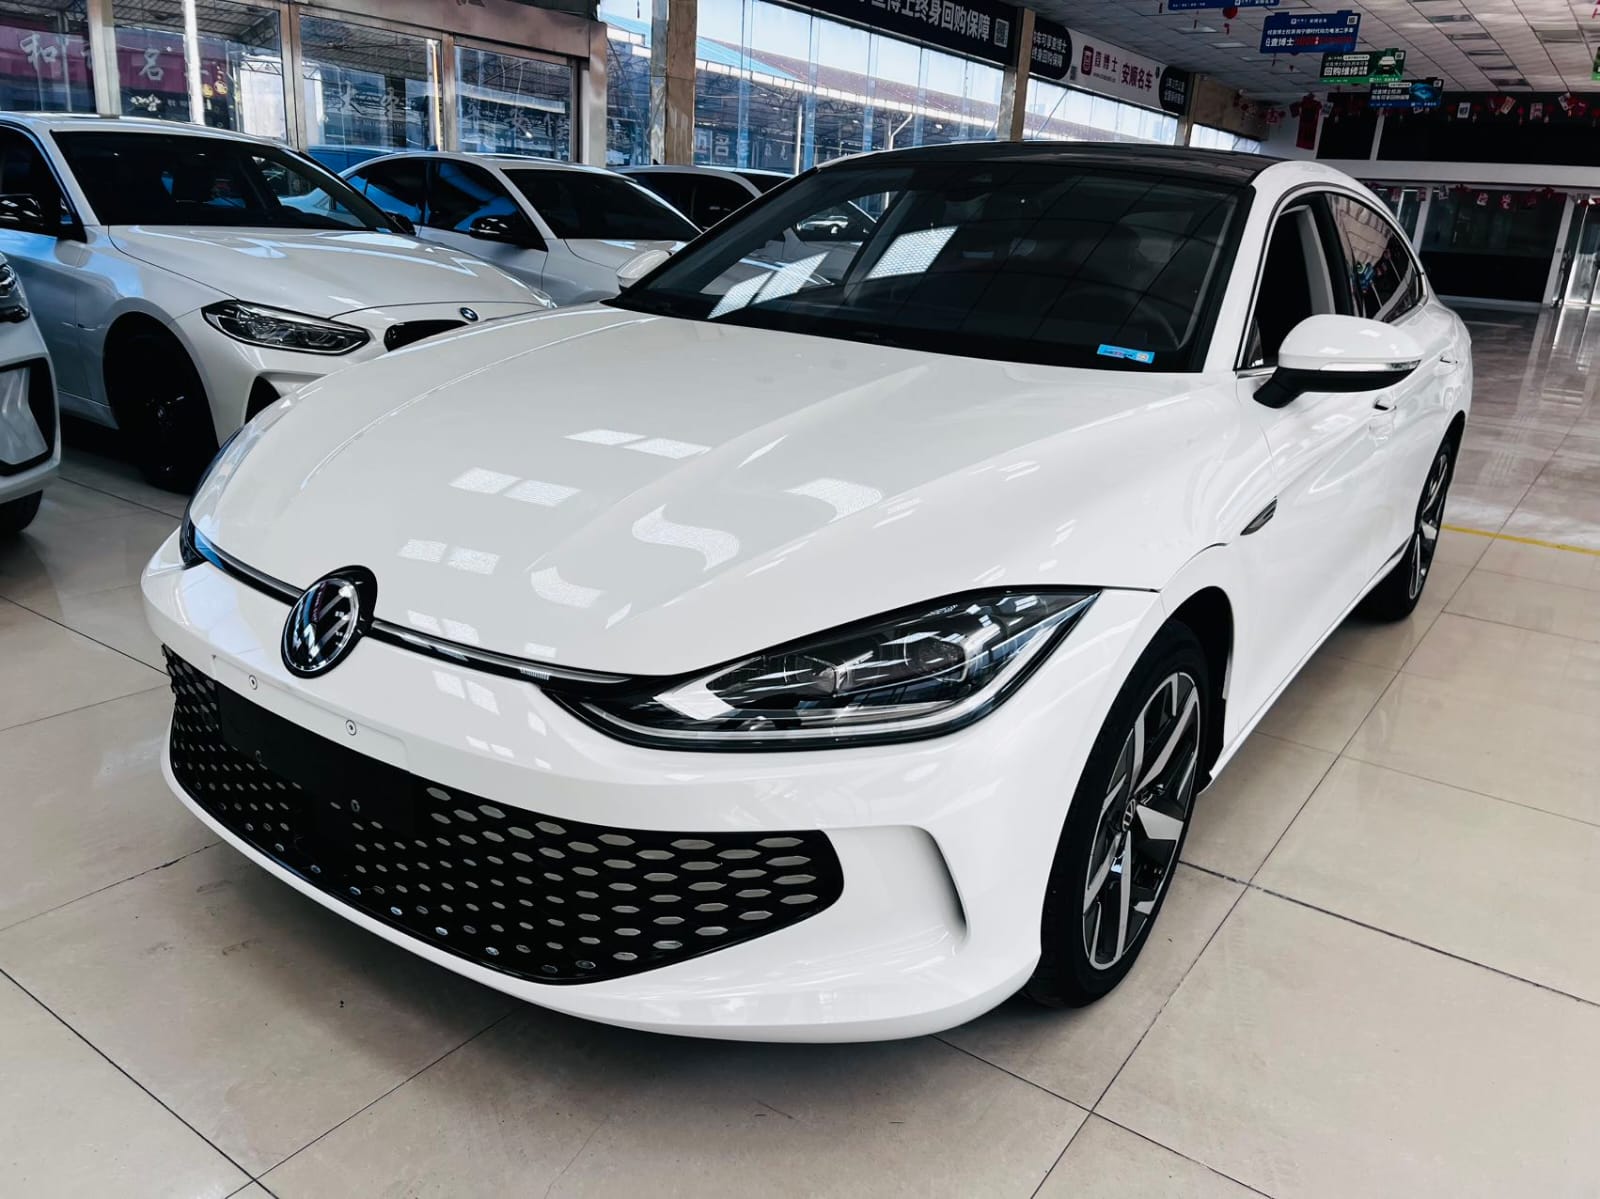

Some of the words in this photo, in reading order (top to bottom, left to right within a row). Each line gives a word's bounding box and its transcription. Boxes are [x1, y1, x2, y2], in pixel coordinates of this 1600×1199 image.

[860, 0, 991, 42] 博士终身回购保障
[1121, 63, 1154, 92] 安顺名车
